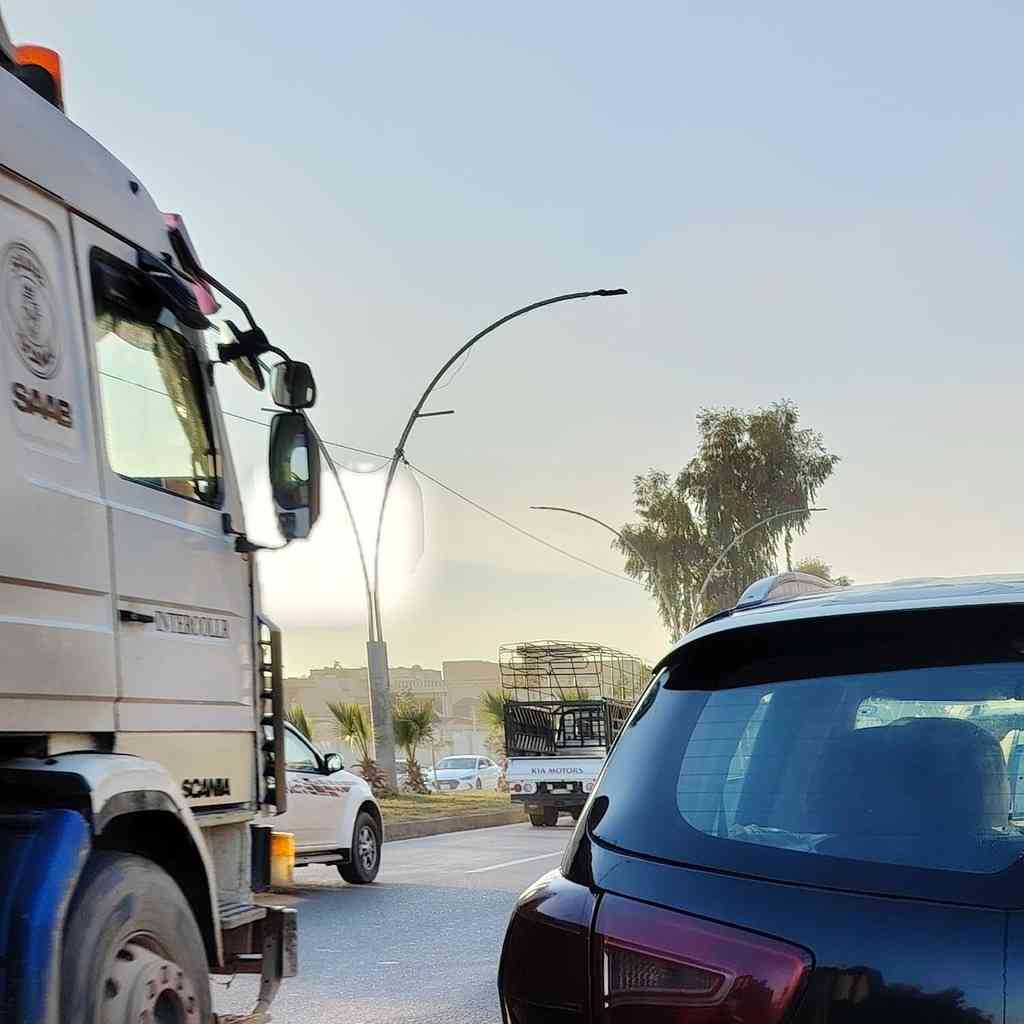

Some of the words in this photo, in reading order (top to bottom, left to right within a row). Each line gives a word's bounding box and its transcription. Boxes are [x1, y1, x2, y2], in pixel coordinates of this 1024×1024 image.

[13, 381, 74, 429] SAAB
[531, 767, 546, 775] KIA
[548, 767, 584, 775] MOTORS
